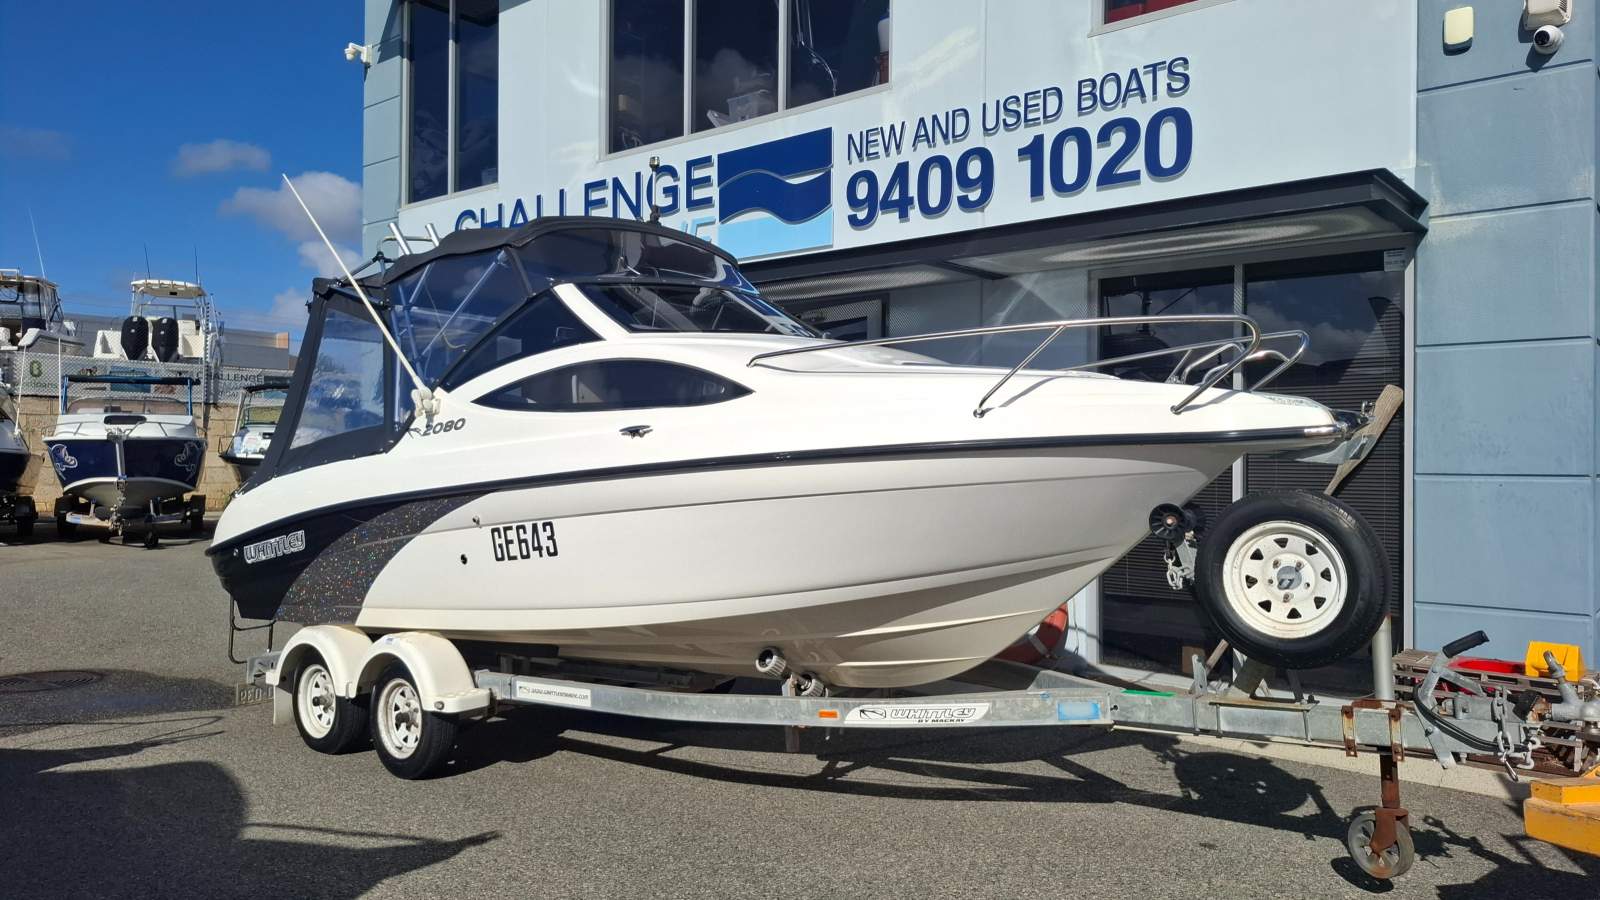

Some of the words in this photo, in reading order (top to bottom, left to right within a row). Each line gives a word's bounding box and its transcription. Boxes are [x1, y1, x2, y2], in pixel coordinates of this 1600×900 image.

[847, 121, 906, 166] NEW
[911, 107, 971, 152] AND
[981, 86, 1064, 137] USED
[1077, 56, 1191, 118] BOATS
[846, 146, 996, 231] 9409
[1017, 106, 1194, 203] 1020
[243, 529, 306, 565] WHITTLEY
[490, 520, 559, 562] GE643
[890, 707, 976, 719] WHITTLEY
